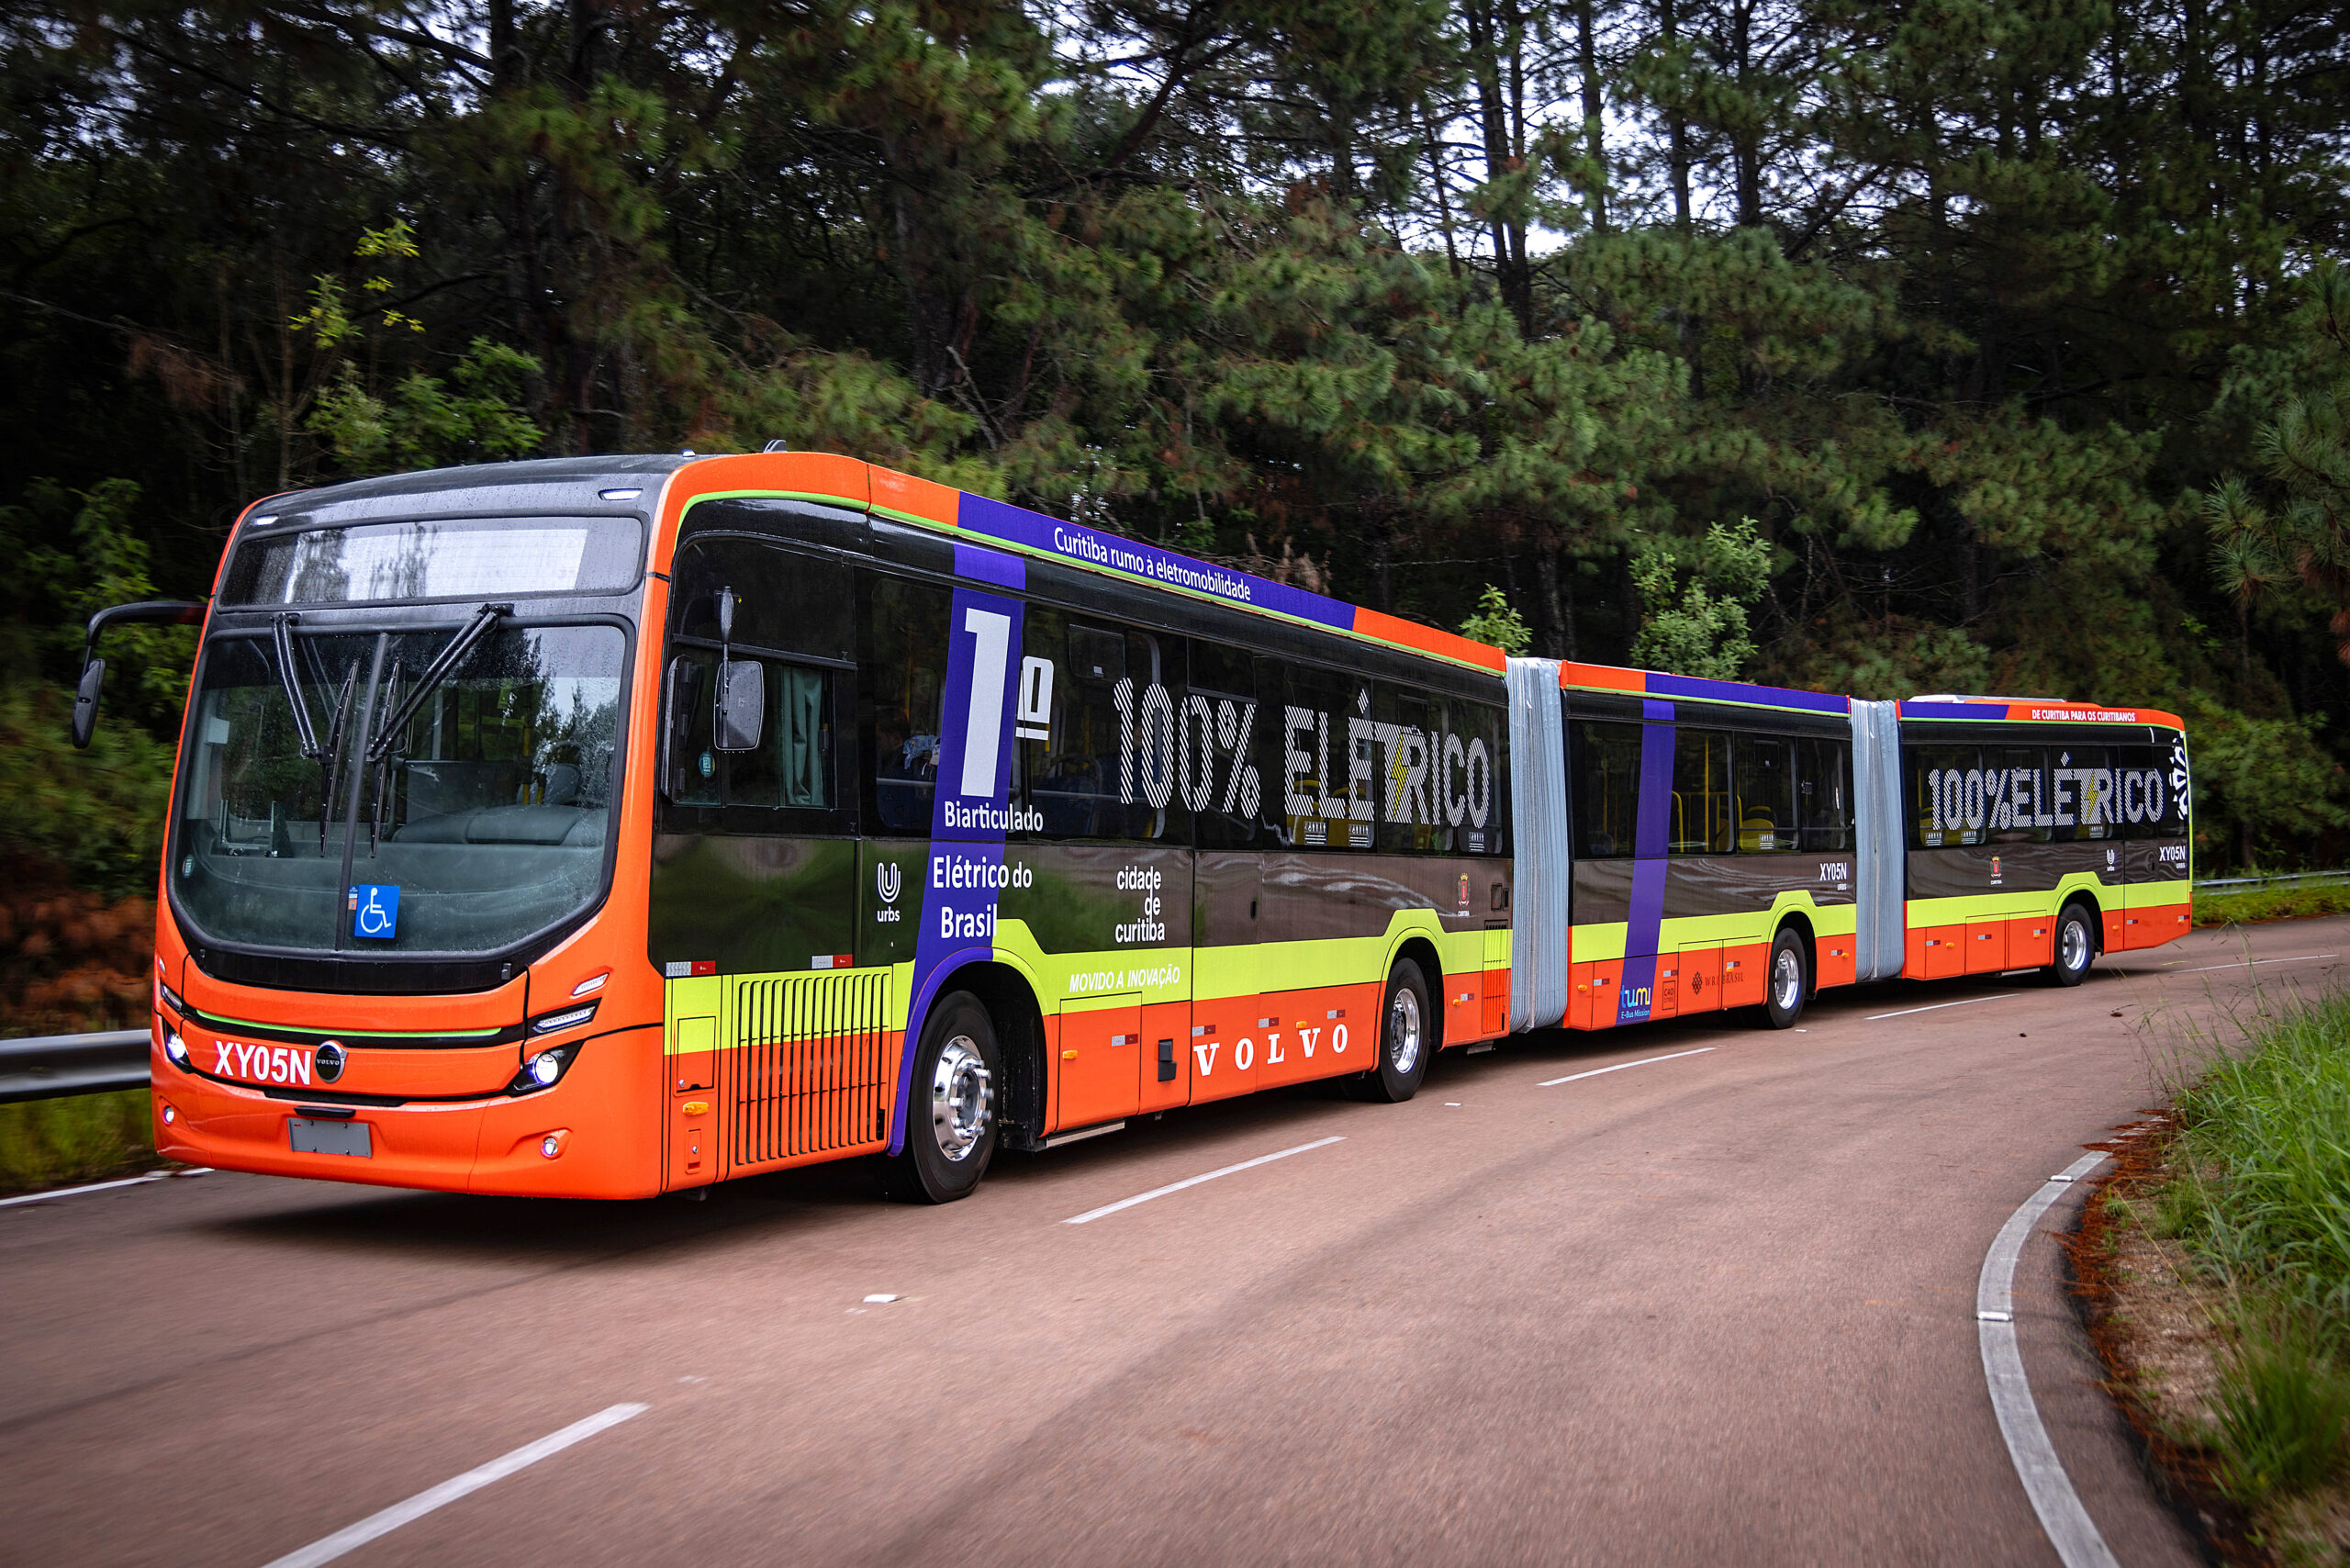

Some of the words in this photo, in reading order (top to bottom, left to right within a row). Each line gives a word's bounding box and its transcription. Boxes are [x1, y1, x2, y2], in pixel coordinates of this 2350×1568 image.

[1054, 526, 1108, 564] Curitiba
[1110, 546, 1145, 573] rumo
[1146, 554, 1155, 576] à
[1156, 557, 1251, 601] eletromobilidade
[2031, 709, 2041, 720] DE
[2042, 710, 2070, 721] CURITIBA
[2071, 711, 2087, 722] PARA
[2087, 711, 2097, 722] OS
[2098, 711, 2136, 722] CURITIBANOS
[1113, 677, 1261, 820] 100%
[1285, 687, 1491, 830] ELÉTRICO
[945, 801, 1044, 833] Biarticulado
[2159, 846, 2186, 862] XY05N
[933, 855, 1010, 889] Elétrico
[1012, 860, 1034, 889] do
[1116, 865, 1162, 890] cidade
[1819, 862, 1847, 881] XY05N
[877, 905, 901, 923] urbs
[1144, 896, 1161, 916] de
[941, 902, 998, 938] Brasil
[1114, 917, 1166, 943] curitiba
[1069, 970, 1114, 992] MOVIDO
[1115, 970, 1124, 989] A
[1127, 963, 1181, 989] INOVAÇÃO
[1619, 984, 1651, 1008] tumi
[1621, 1010, 1634, 1019] E-Bus
[1634, 1008, 1651, 1017] Mission
[214, 1040, 311, 1086] XY05N
[316, 1058, 341, 1067] VOLVO
[1192, 1024, 1348, 1077] VOLVO
